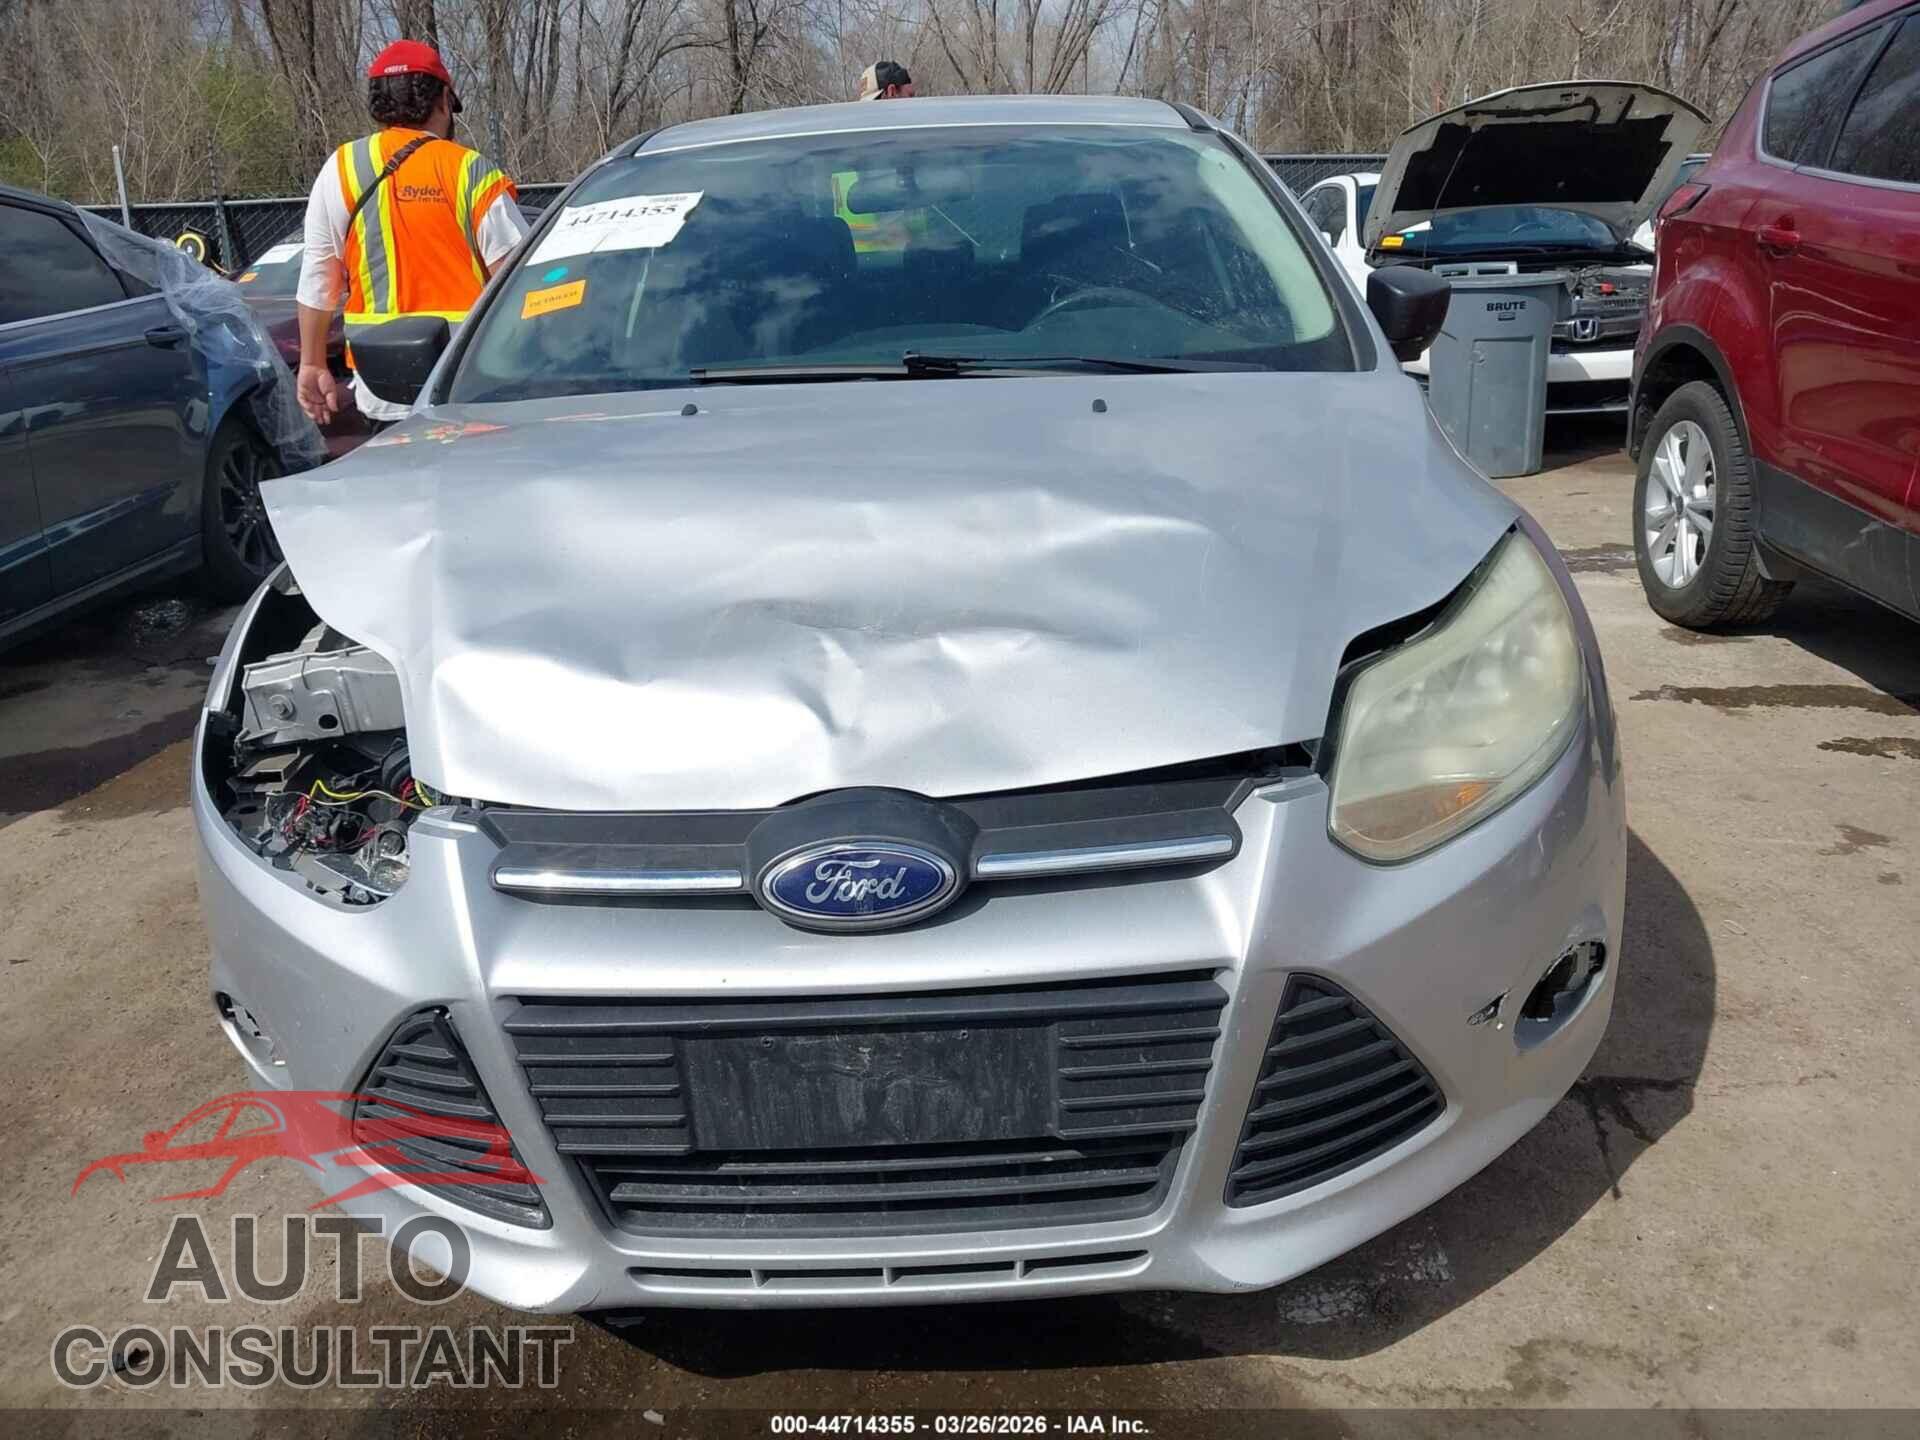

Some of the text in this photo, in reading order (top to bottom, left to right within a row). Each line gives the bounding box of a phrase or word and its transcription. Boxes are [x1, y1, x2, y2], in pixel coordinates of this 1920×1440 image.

[402, 184, 443, 198] Ryder
[567, 204, 679, 227] 44714355
[1486, 300, 1528, 312] BRUTE
[805, 859, 907, 904] Ford
